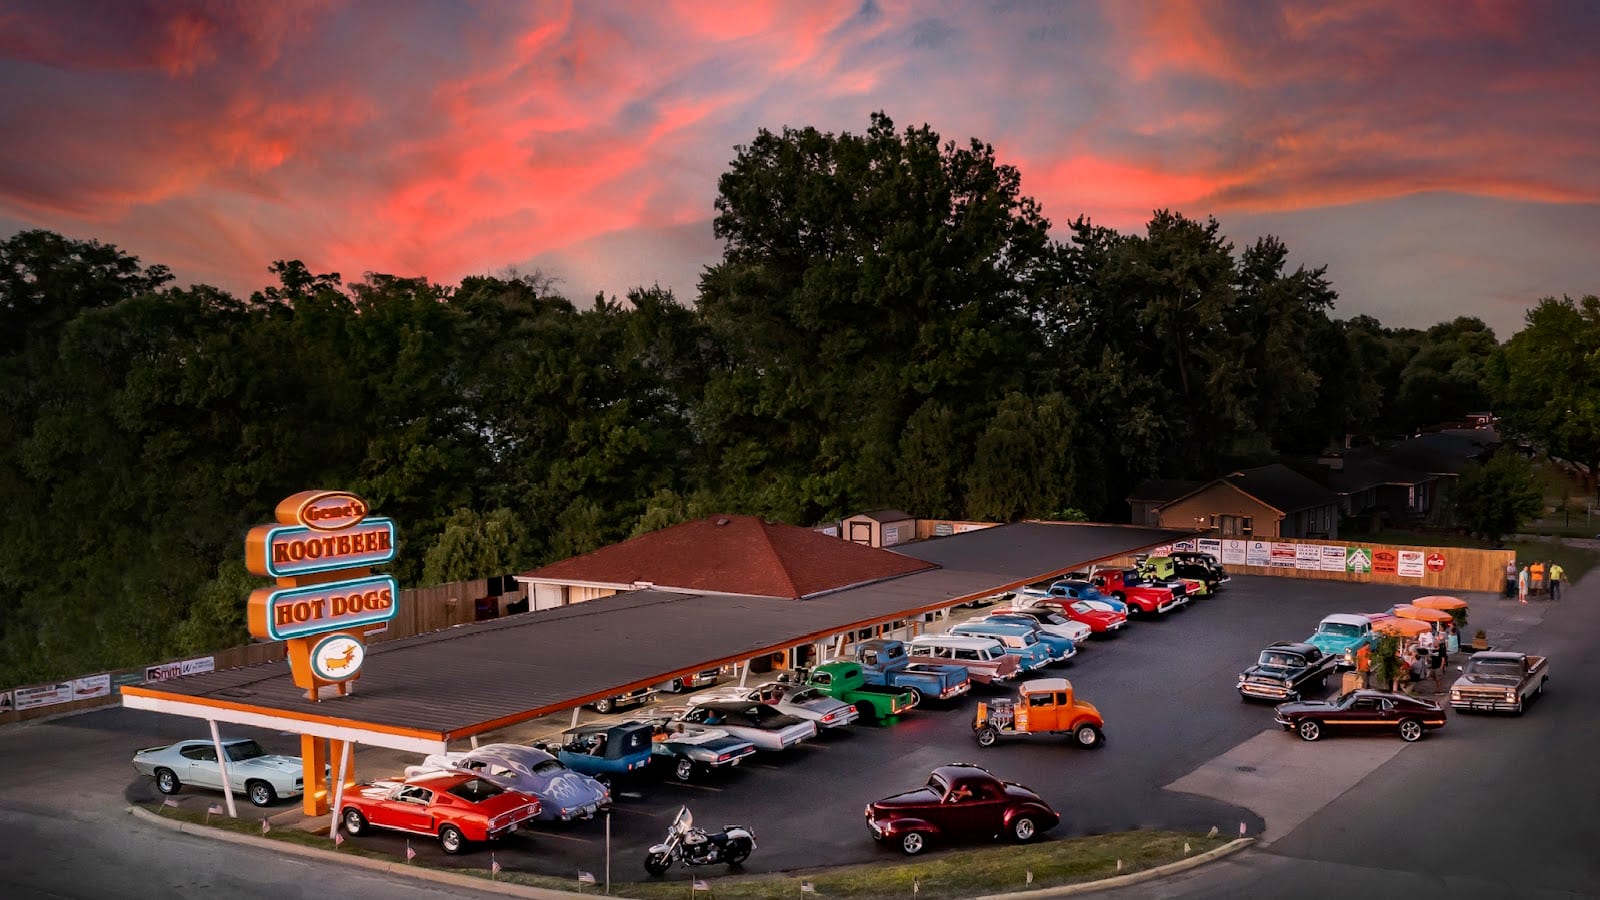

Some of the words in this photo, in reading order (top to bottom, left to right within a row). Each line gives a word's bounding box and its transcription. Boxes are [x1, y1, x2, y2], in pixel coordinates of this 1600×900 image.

[274, 531, 392, 562] ROOTBEER
[276, 599, 325, 625] HOT
[331, 589, 392, 617] DOGS
[154, 665, 181, 680] Smith
